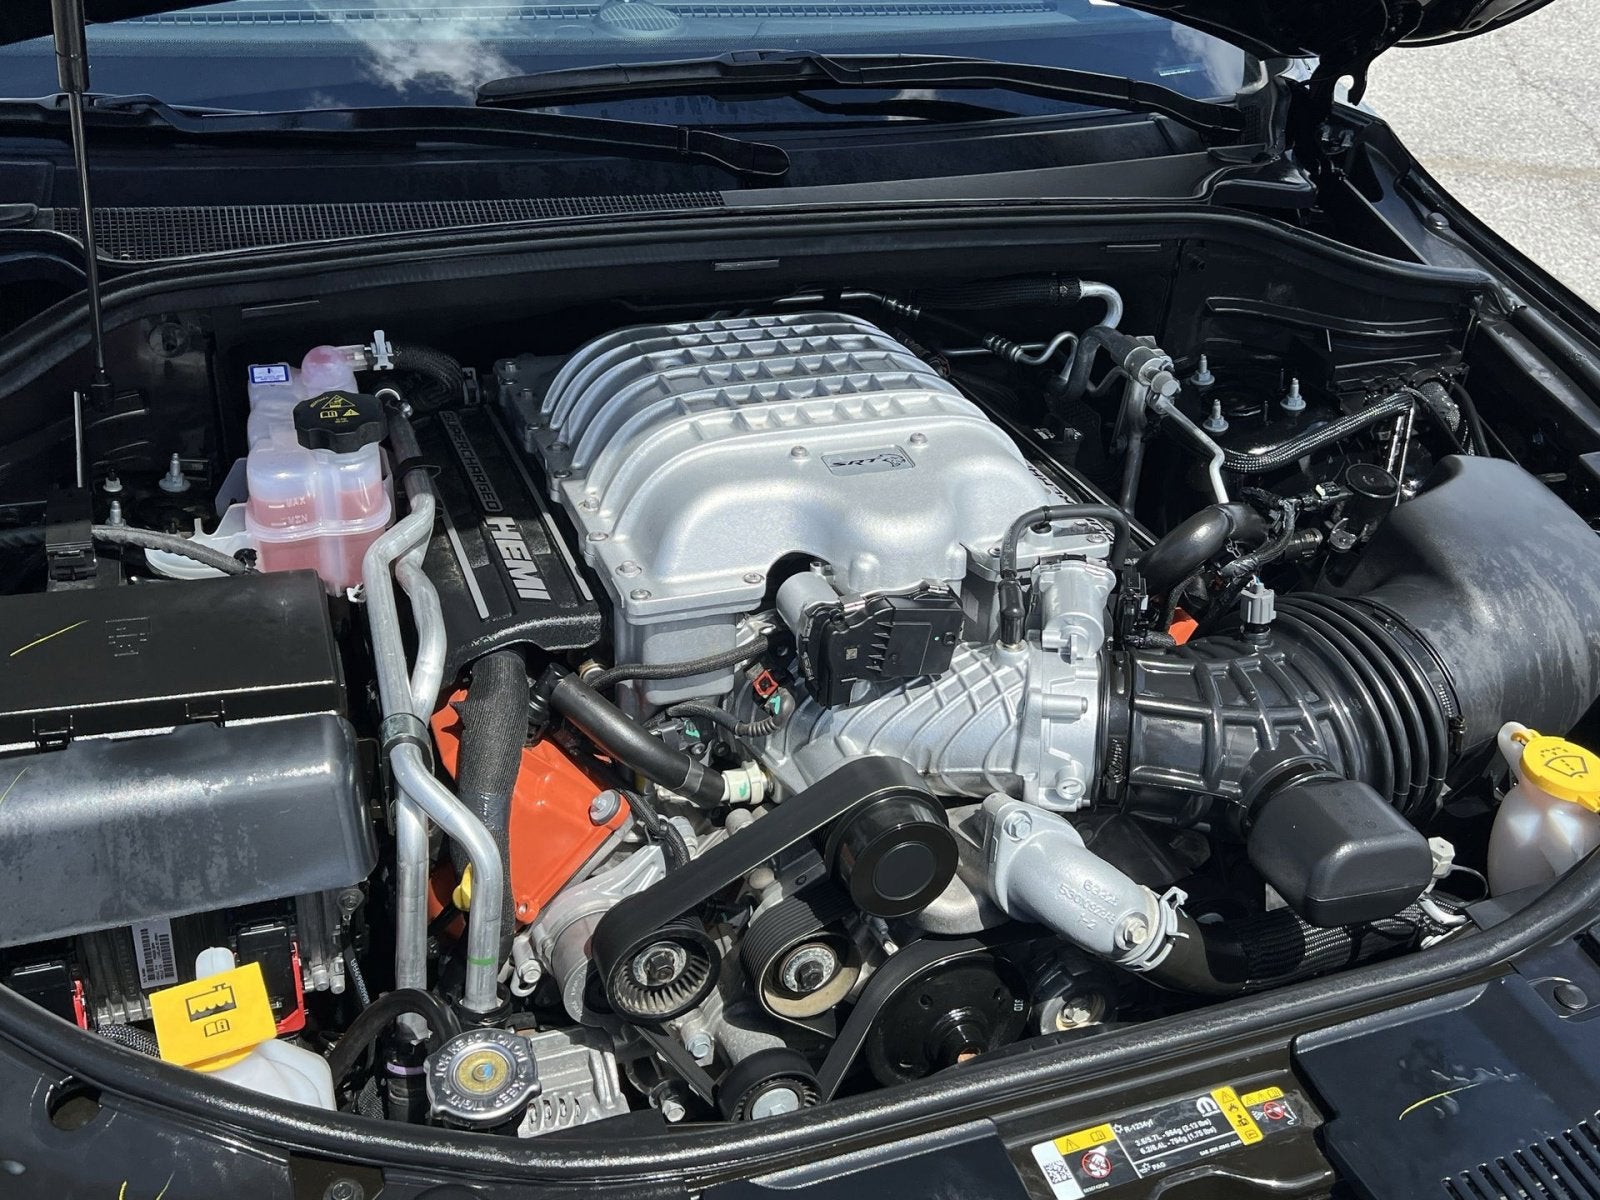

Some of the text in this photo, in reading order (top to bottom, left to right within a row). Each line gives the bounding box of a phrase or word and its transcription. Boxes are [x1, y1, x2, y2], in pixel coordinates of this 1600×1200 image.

[440, 411, 501, 511] SUPERCHARGED
[831, 458, 876, 468] SRT
[286, 495, 306, 508] MAX
[288, 513, 308, 525] MIN
[484, 516, 552, 600] HEMI
[494, 1080, 527, 1108] KEEP
